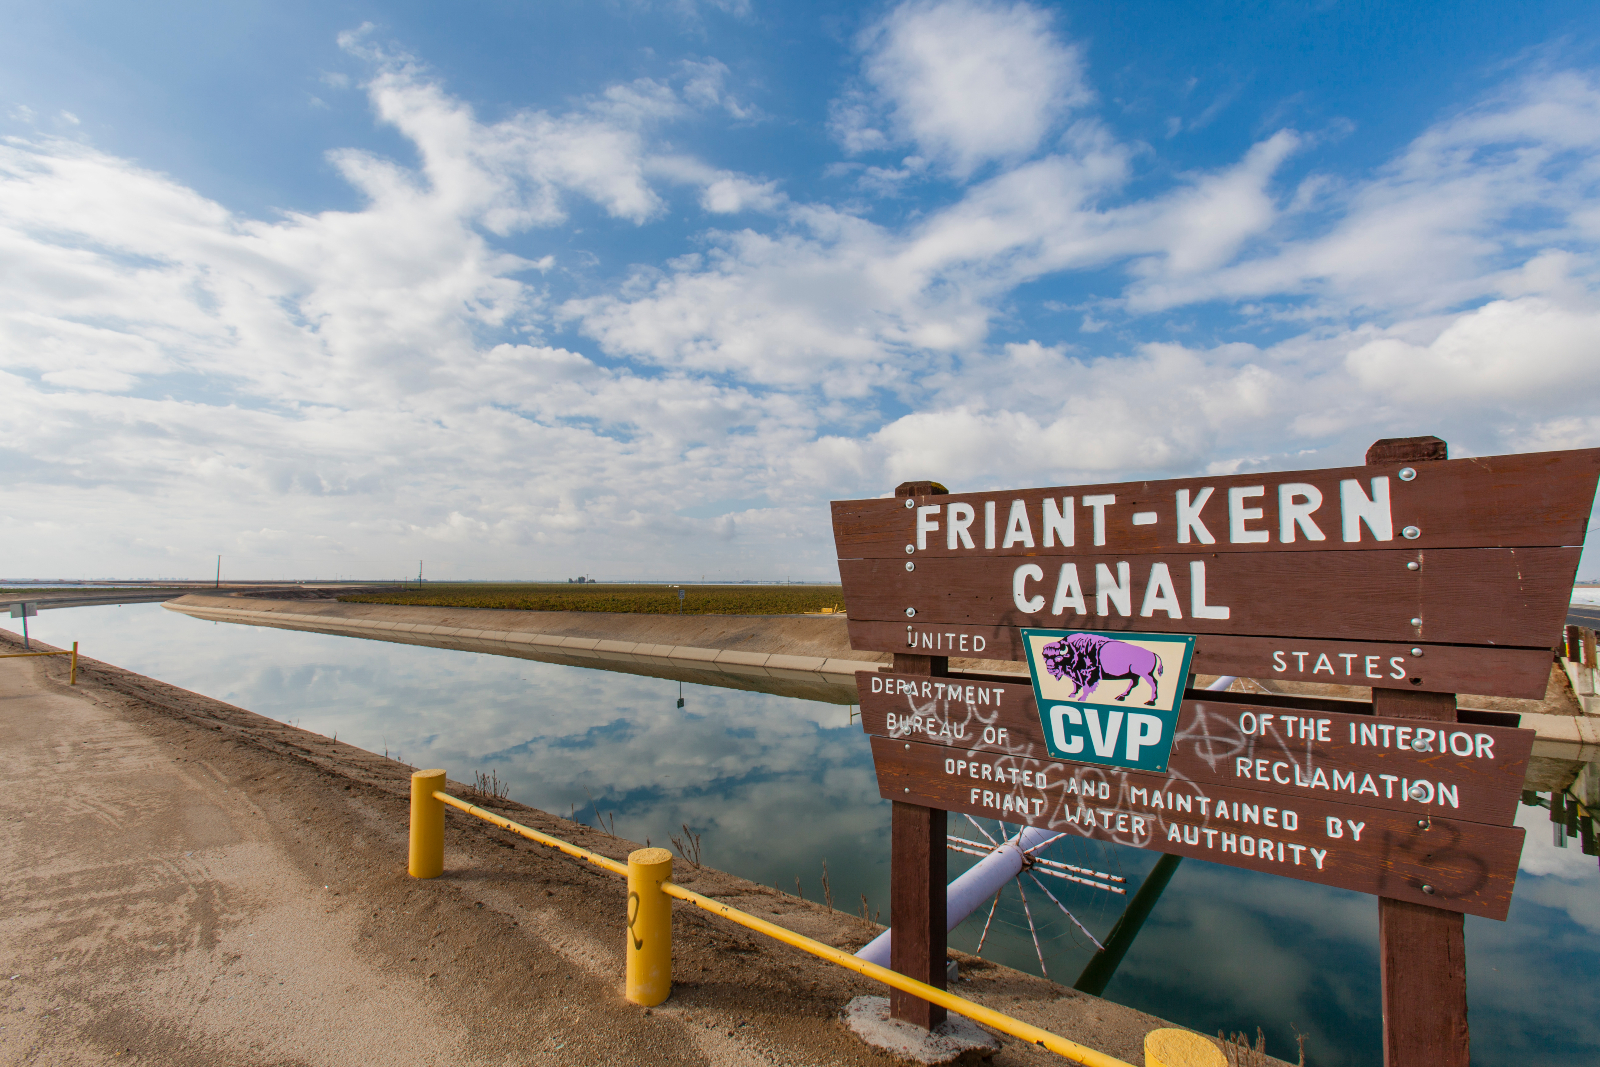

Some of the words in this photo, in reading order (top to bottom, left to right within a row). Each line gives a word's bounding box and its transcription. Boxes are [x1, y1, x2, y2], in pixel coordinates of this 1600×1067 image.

[1013, 561, 1230, 619] CANAL
[907, 631, 986, 652] UNITED
[1272, 650, 1406, 679] STATES
[871, 676, 1004, 706] DEPARTMENT
[1239, 712, 1274, 735] OF
[1280, 715, 1332, 742] THE
[1349, 722, 1494, 759] INTERIOR
[1049, 704, 1163, 761] CVP
[886, 712, 965, 739] BUREAU
[983, 726, 1007, 745] OF
[1236, 756, 1459, 808] RECLAMATION
[945, 758, 1047, 789] OPERATED
[1067, 777, 1110, 800] AND
[1130, 786, 1298, 831] MAINTAINED
[1326, 816, 1365, 841] BY
[970, 788, 1044, 817] FRIANT
[1064, 804, 1146, 836] WATER
[1167, 823, 1327, 869] AUTHORITY
